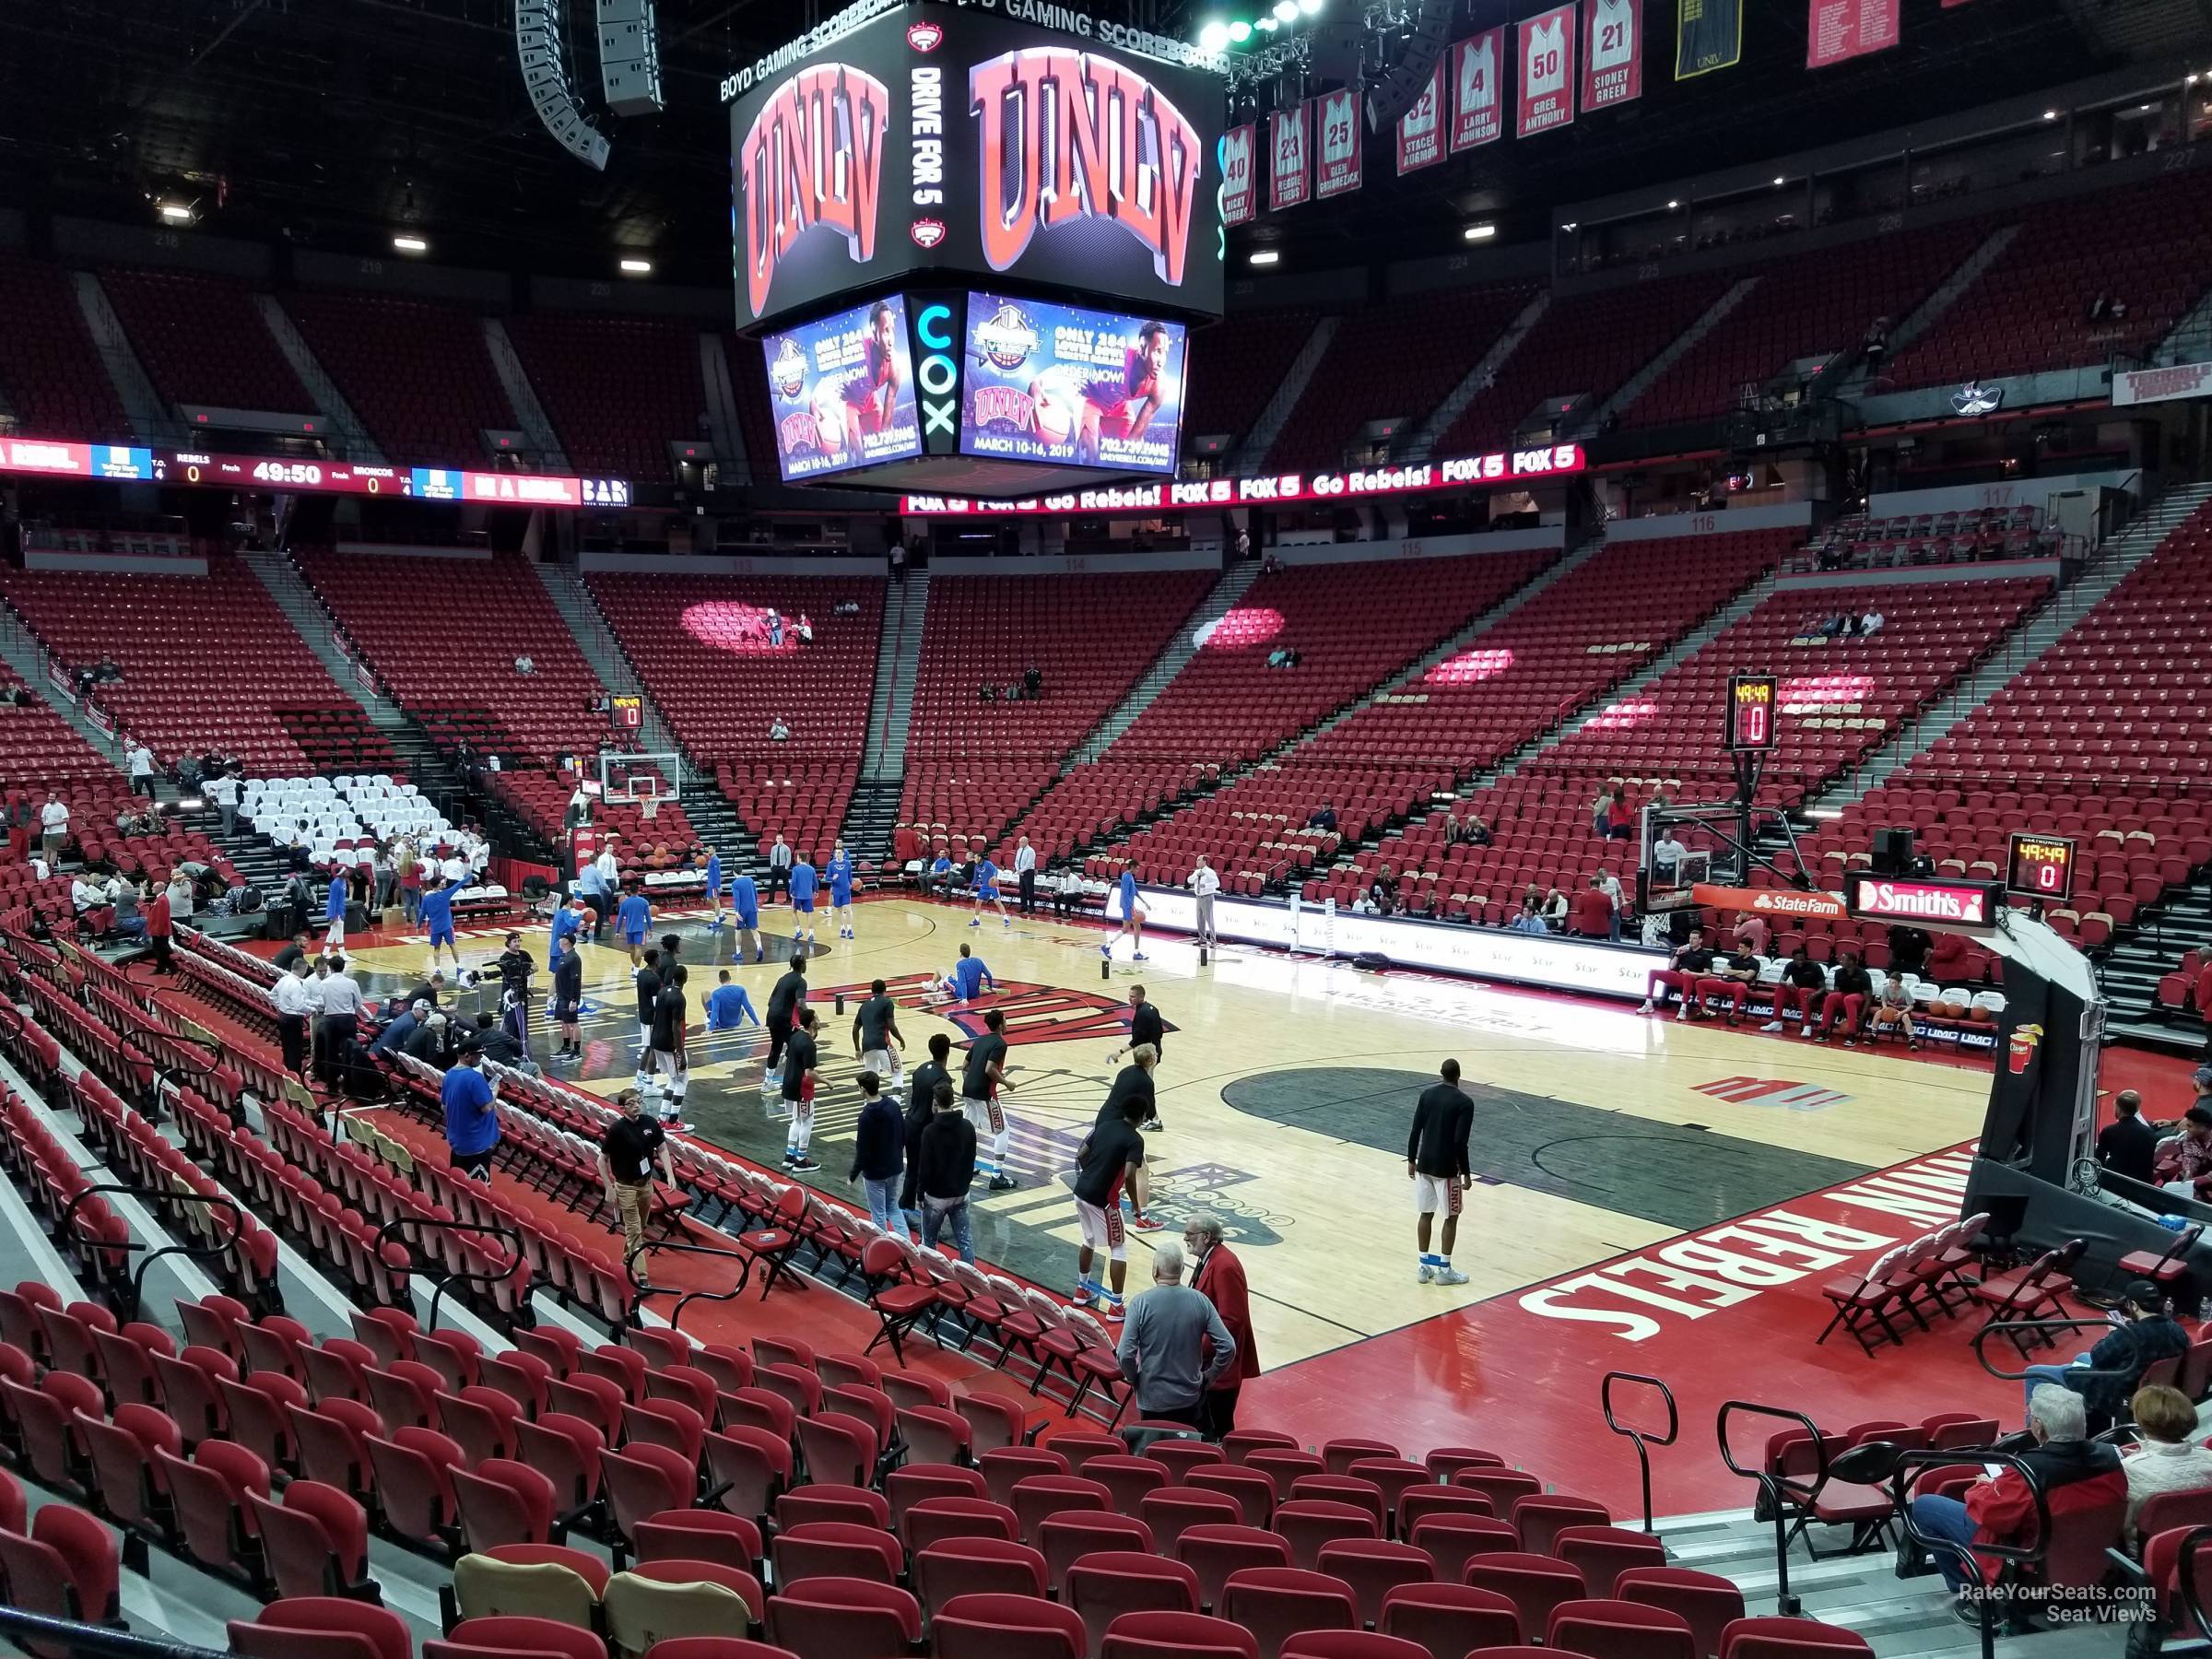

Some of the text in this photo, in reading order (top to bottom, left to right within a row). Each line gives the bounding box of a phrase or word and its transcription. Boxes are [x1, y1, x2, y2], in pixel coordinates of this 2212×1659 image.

[1006, 0, 1091, 37] GAMING
[1600, 20, 1625, 53] 21
[721, 67, 752, 101] BOYD
[756, 34, 806, 81] GAMING
[1533, 49, 1559, 80] 50
[1472, 67, 1485, 93] 4
[1594, 68, 1629, 89] SIDNEY
[911, 67, 942, 135] DRIVE
[1596, 83, 1627, 103] GREEN
[1534, 97, 1557, 115] GREG
[1464, 111, 1491, 130] LARRY
[1525, 108, 1566, 131] ANTHONY
[1328, 122, 1349, 147] 25
[1405, 134, 1436, 154] STACEY
[1457, 122, 1497, 145] JOHNSON
[1280, 135, 1300, 160] 23
[912, 139, 943, 184] FOR
[969, 46, 1202, 287] UNLV
[1227, 157, 1245, 182] 40
[1330, 162, 1347, 178] GLEN
[740, 62, 890, 319] UNLV
[912, 189, 943, 205] 5
[917, 305, 958, 435] COX
[974, 386, 1034, 431] UNLV
[973, 436, 1075, 457] MARCH 10-16, 2019
[176, 453, 210, 465] REBELS
[221, 464, 241, 473] Fouls
[1441, 454, 1505, 482] FOX 5
[1512, 444, 1576, 475] FOX 5
[155, 467, 164, 479] 4
[187, 465, 199, 482] 0
[253, 462, 322, 484] 49:50
[1312, 465, 1430, 495] Go Rebels!
[368, 477, 380, 493] 0
[403, 486, 411, 496] 4
[1171, 479, 1232, 504] FOX 5
[1240, 476, 1300, 500] FOX 5
[1983, 487, 2013, 506] 117
[1080, 488, 1161, 509] Rebels!
[1691, 515, 1715, 532] 116
[1401, 540, 1421, 556] 115
[1736, 684, 1770, 703] 49:49
[628, 708, 638, 725] 0
[1750, 706, 1764, 741] 0
[2019, 842, 2066, 864] 49:49
[2040, 865, 2055, 888] 0
[1877, 883, 1962, 917] Smith's
[1384, 971, 1491, 991] CENTER
[1747, 1005, 1774, 1015] UMC
[1927, 1029, 1959, 1041] UMC
[1960, 1033, 1994, 1047] UMC
[888, 1046, 901, 1071] UNLV
[991, 1105, 1002, 1131] UNLV
[1110, 1211, 1122, 1243] UNLV
[1518, 1209, 1900, 1343] REBELS
